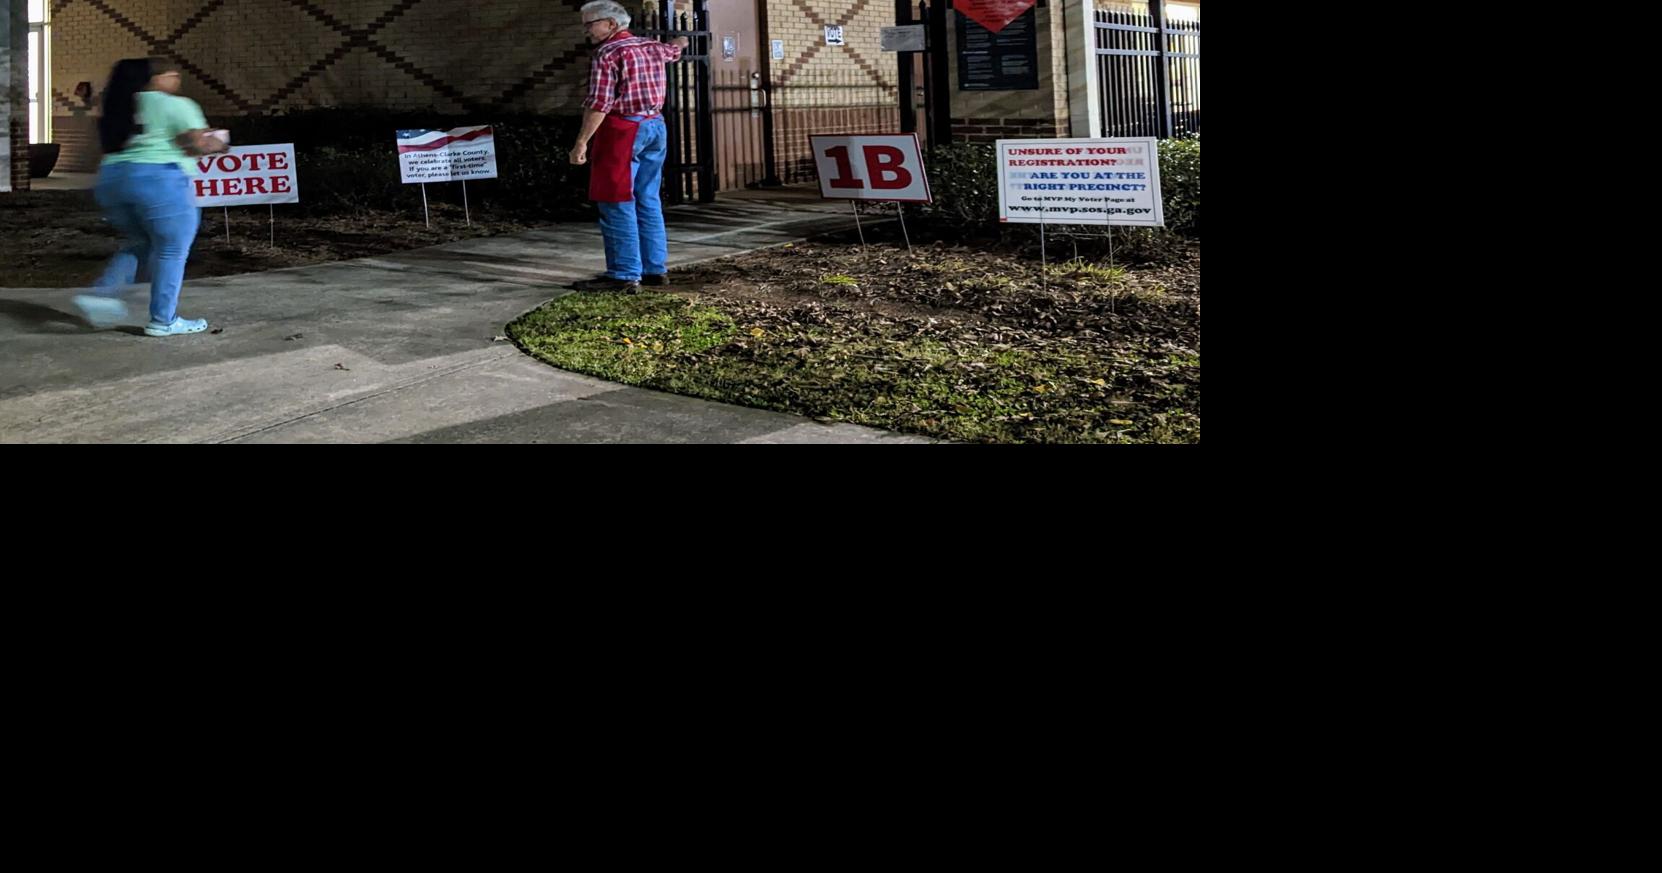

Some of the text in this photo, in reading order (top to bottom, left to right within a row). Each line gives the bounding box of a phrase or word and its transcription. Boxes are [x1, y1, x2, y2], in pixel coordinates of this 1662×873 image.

[1008, 146, 1127, 156] UNSURE OF YOUR
[196, 152, 289, 174] VOTE
[824, 145, 913, 190] 1B
[1008, 159, 1117, 167] REGISTRATION?
[1030, 172, 1146, 180] ARE YOU AT THE
[193, 175, 291, 197] HERE
[1023, 183, 1146, 191] RIGHT PRECINCT?
[1008, 205, 1152, 216] www.mvp.sos.ga.gov
